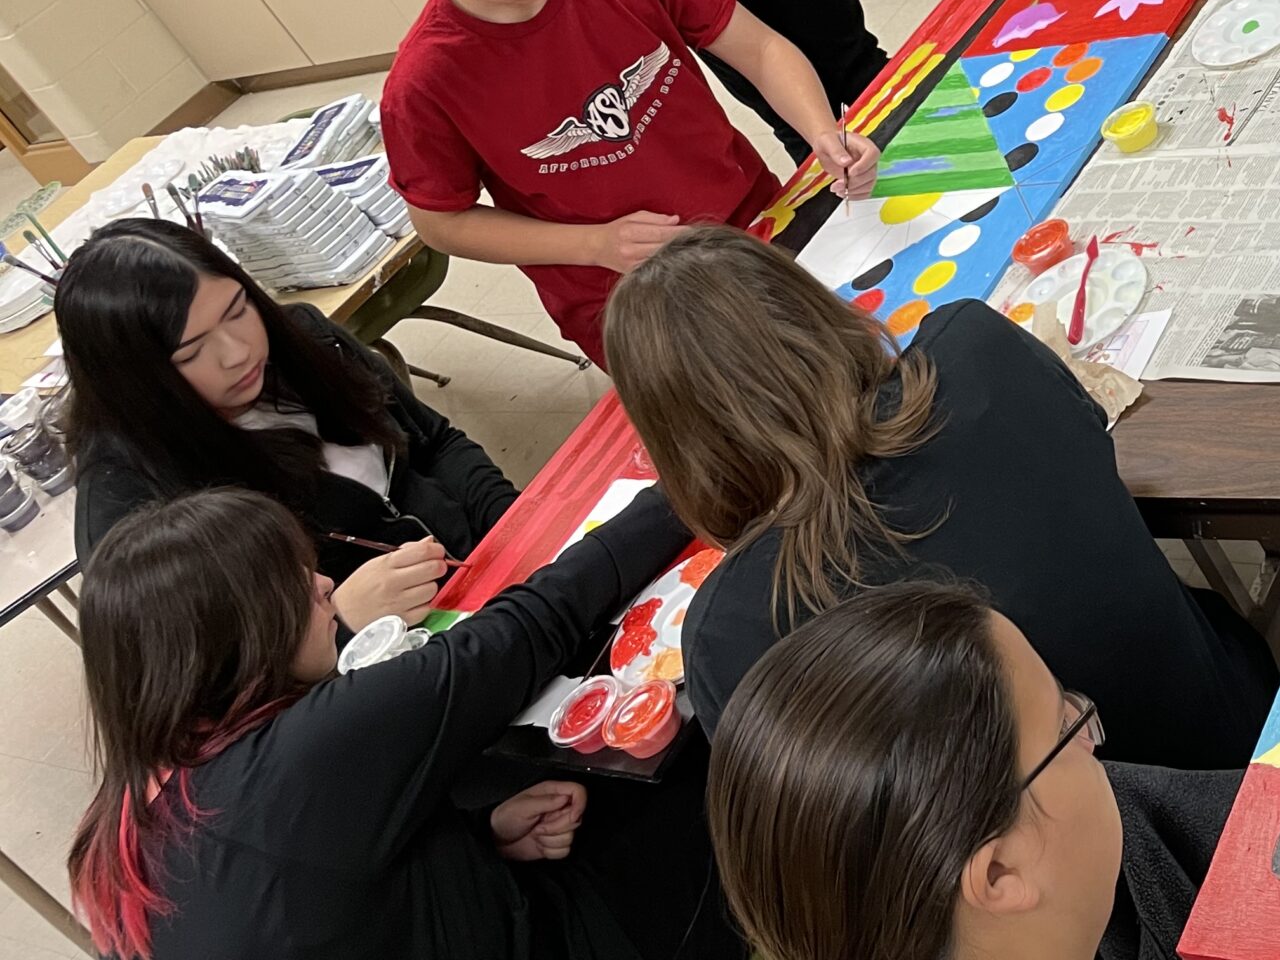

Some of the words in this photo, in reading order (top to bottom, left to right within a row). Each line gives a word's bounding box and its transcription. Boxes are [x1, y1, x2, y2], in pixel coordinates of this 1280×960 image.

[538, 143, 635, 174] AFFORDABLE
[632, 99, 663, 144] STREET
[659, 58, 682, 95] RODS
